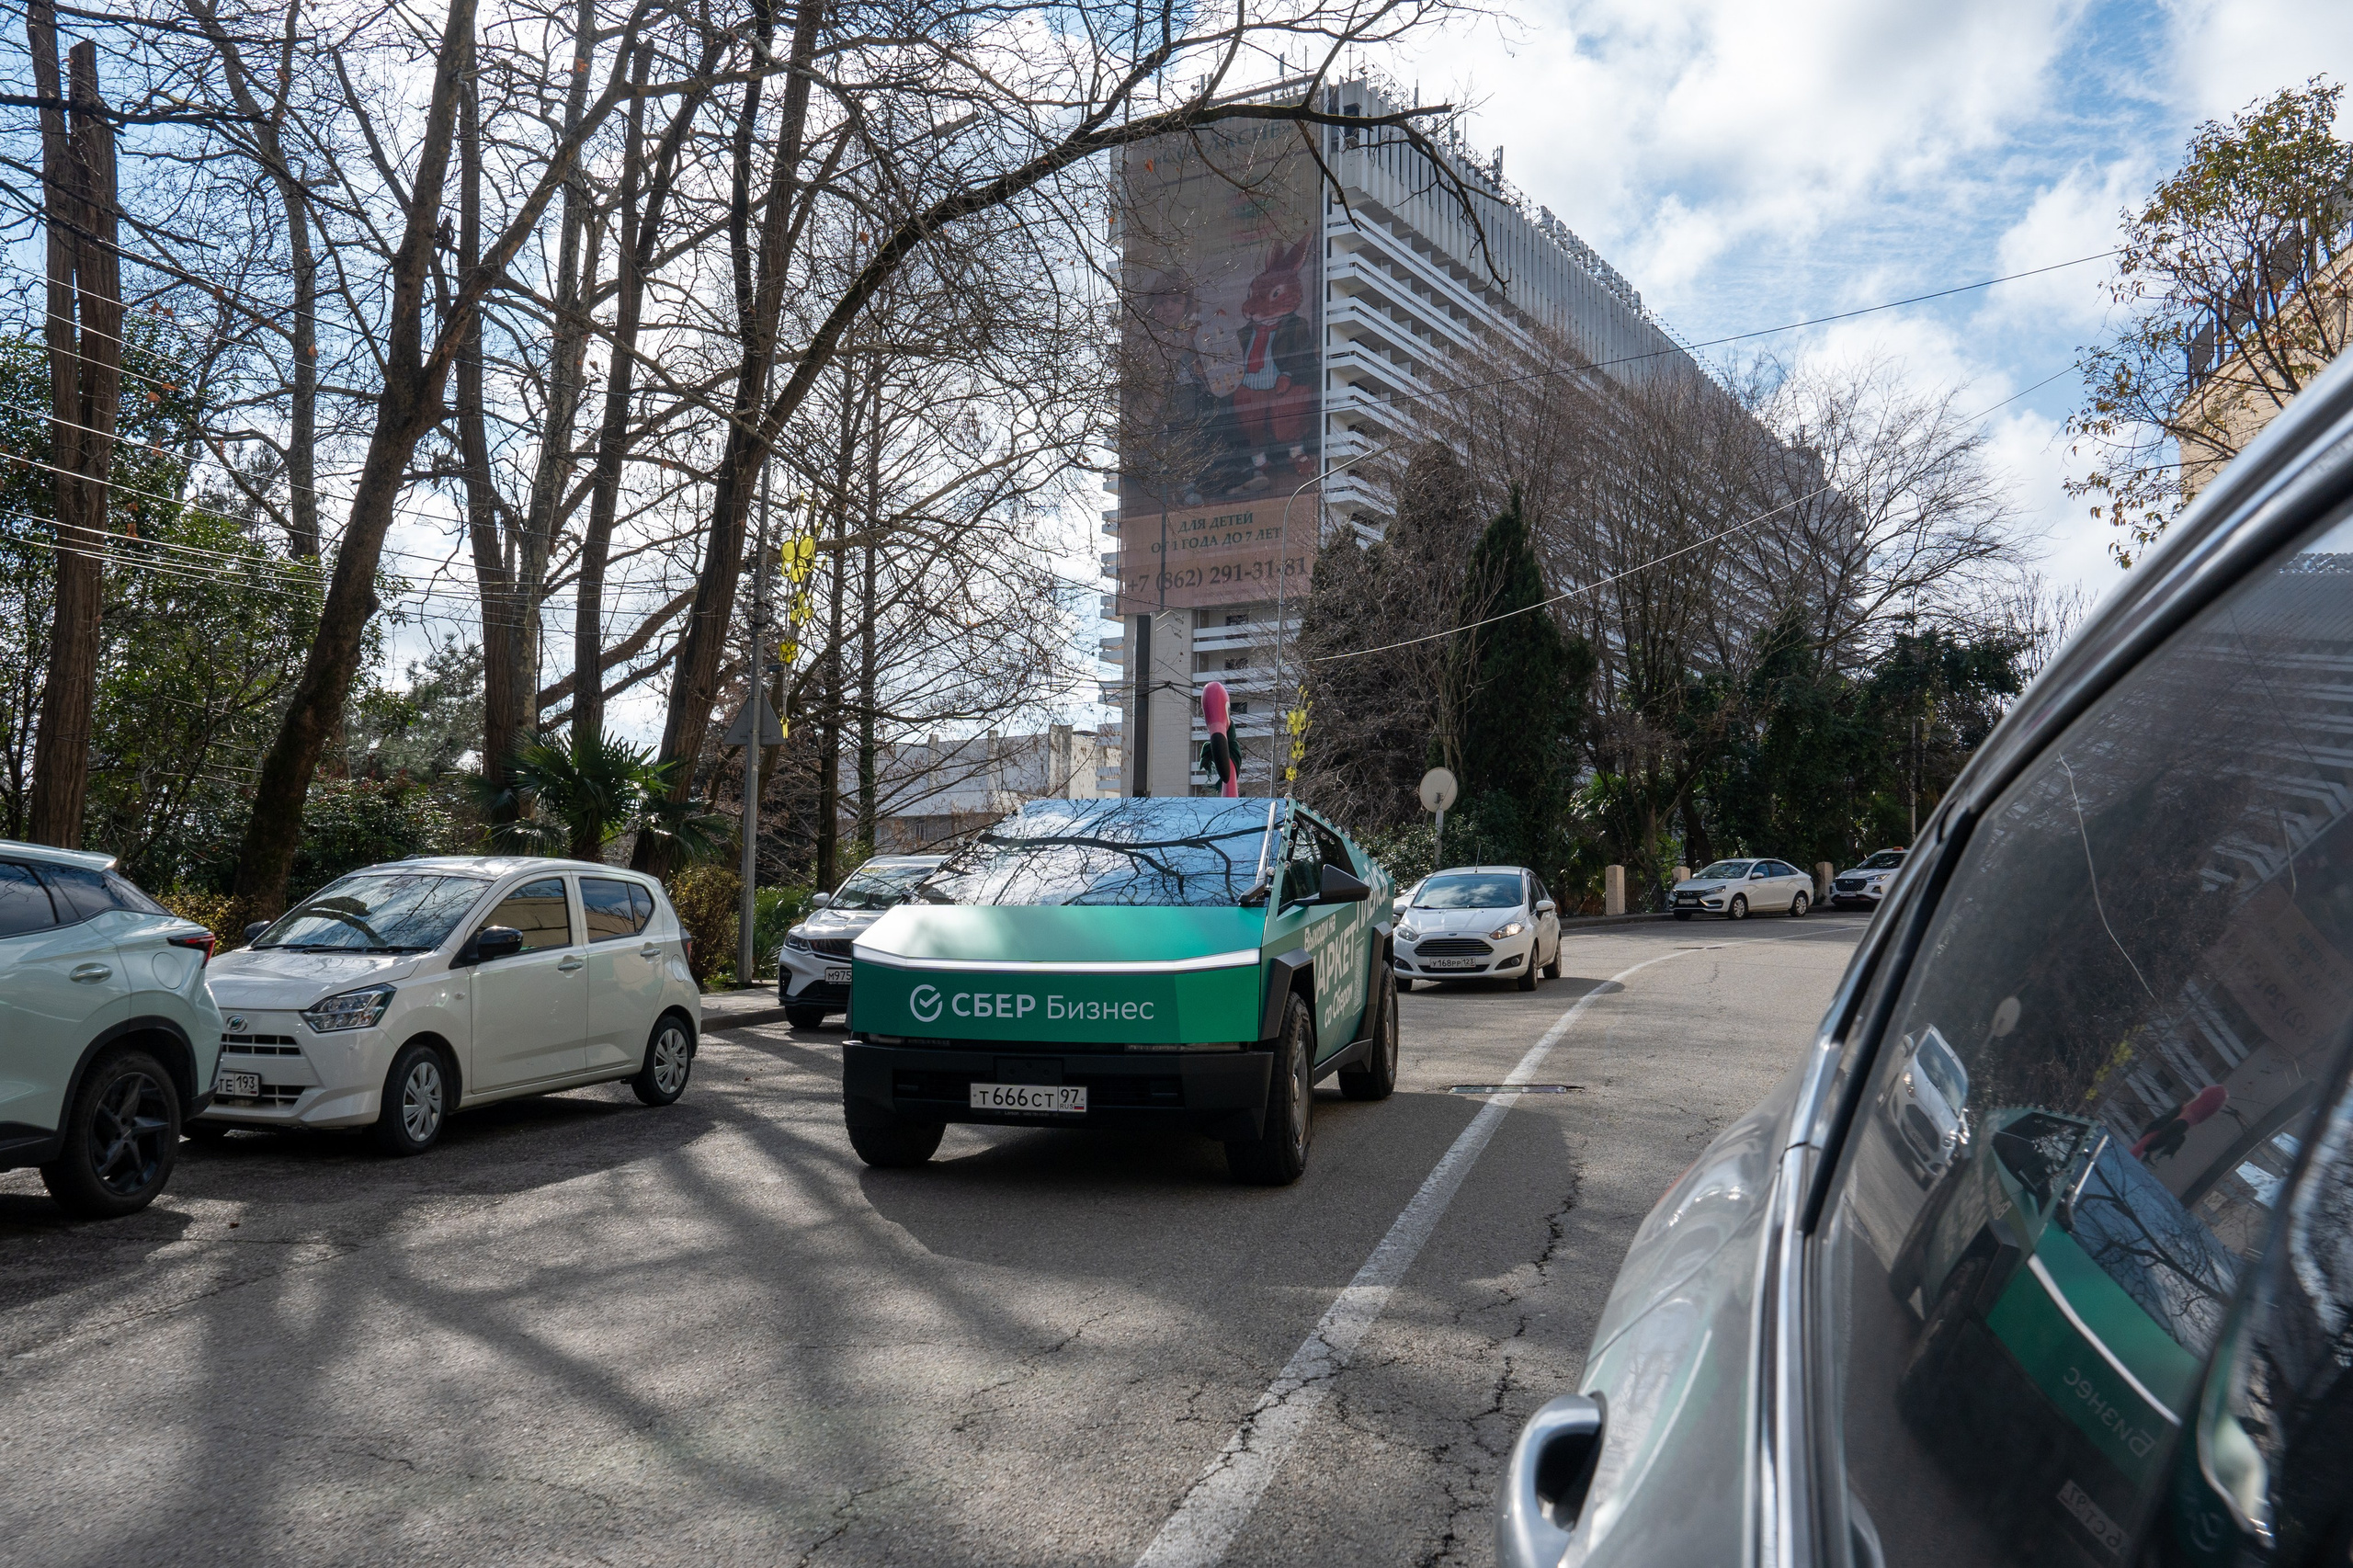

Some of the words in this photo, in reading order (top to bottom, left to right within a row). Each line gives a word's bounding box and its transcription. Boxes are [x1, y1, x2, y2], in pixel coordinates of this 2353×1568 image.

[1178, 517, 1206, 534] ДЛЯ
[1209, 510, 1253, 529] ДЕТЕЙ
[1151, 539, 1169, 553] ОТ
[1173, 539, 1178, 551] 1
[1182, 535, 1219, 551] ГОДА
[1222, 531, 1243, 547] ДО
[1245, 531, 1252, 544] 7
[1256, 527, 1282, 541] ЛЕТ
[1128, 574, 1150, 593] +7
[1155, 566, 1203, 593] (862)
[1210, 556, 1307, 585] 291-31-81
[1304, 926, 1328, 952] Выходи
[1328, 913, 1336, 936] на
[1432, 959, 1461, 967] У168РР
[828, 971, 852, 981] М975
[951, 992, 1036, 1019] СБЕР
[1047, 994, 1154, 1021] Бизнес
[1324, 1004, 1332, 1028] со
[1332, 981, 1354, 1019] Сбером
[235, 1074, 256, 1089] 193
[979, 1087, 1054, 1108] Т666СТ
[1060, 1088, 1079, 1104] 97
